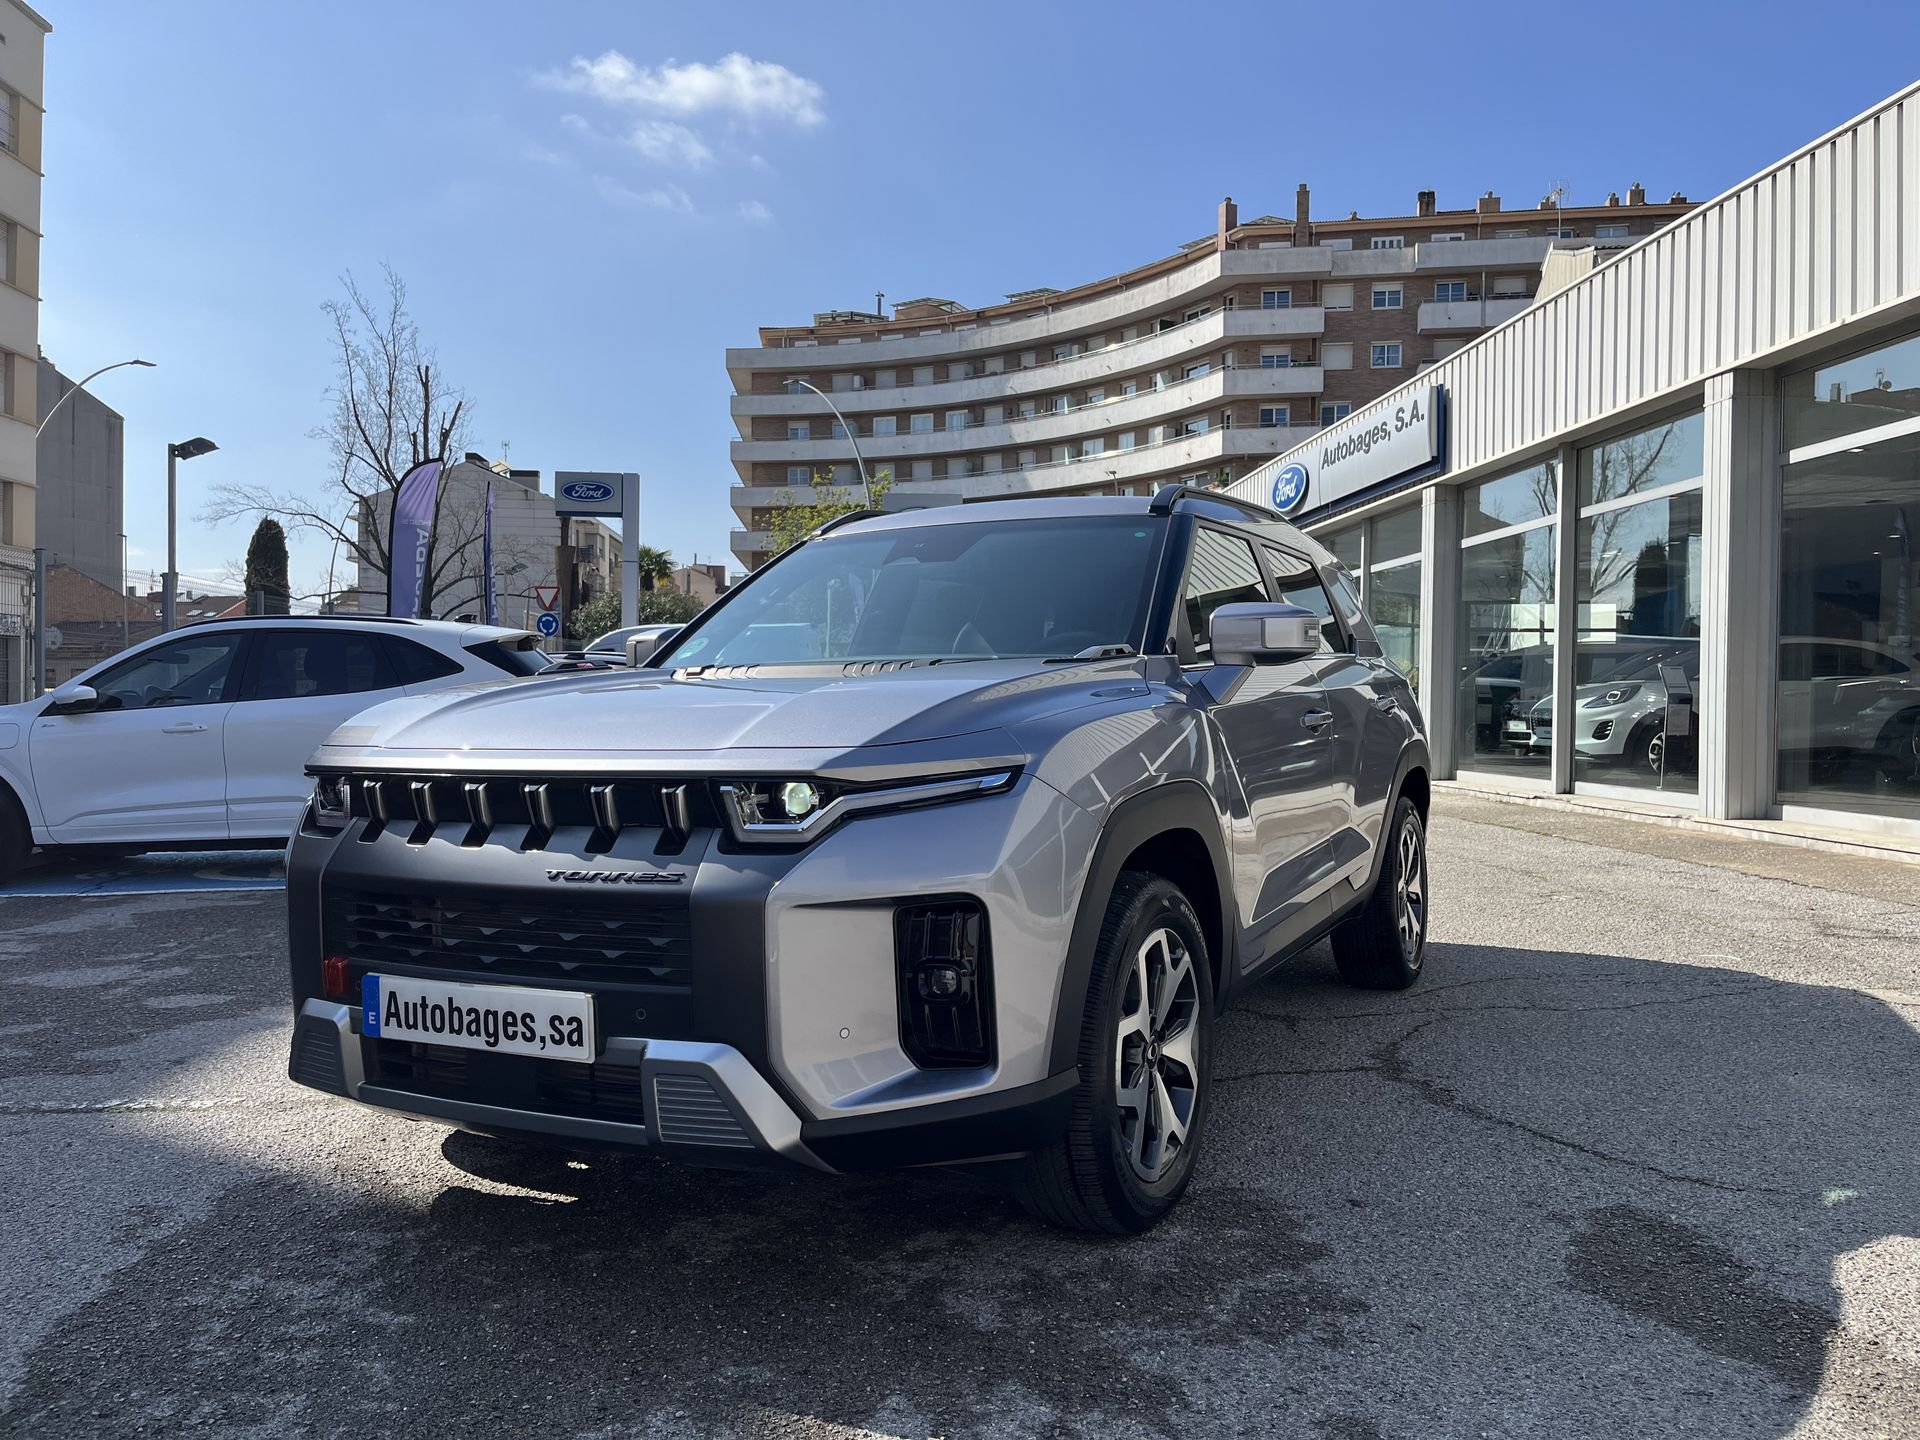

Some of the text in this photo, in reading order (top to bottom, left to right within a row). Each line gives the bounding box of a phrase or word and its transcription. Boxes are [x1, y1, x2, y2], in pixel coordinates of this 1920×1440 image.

[1321, 399, 1425, 470] Autobages, S.A.
[572, 484, 605, 498] Ford
[1276, 471, 1298, 504] Ford
[545, 869, 688, 884] TORRES
[368, 1011, 377, 1025] E
[384, 990, 584, 1051] Autobages,sa
